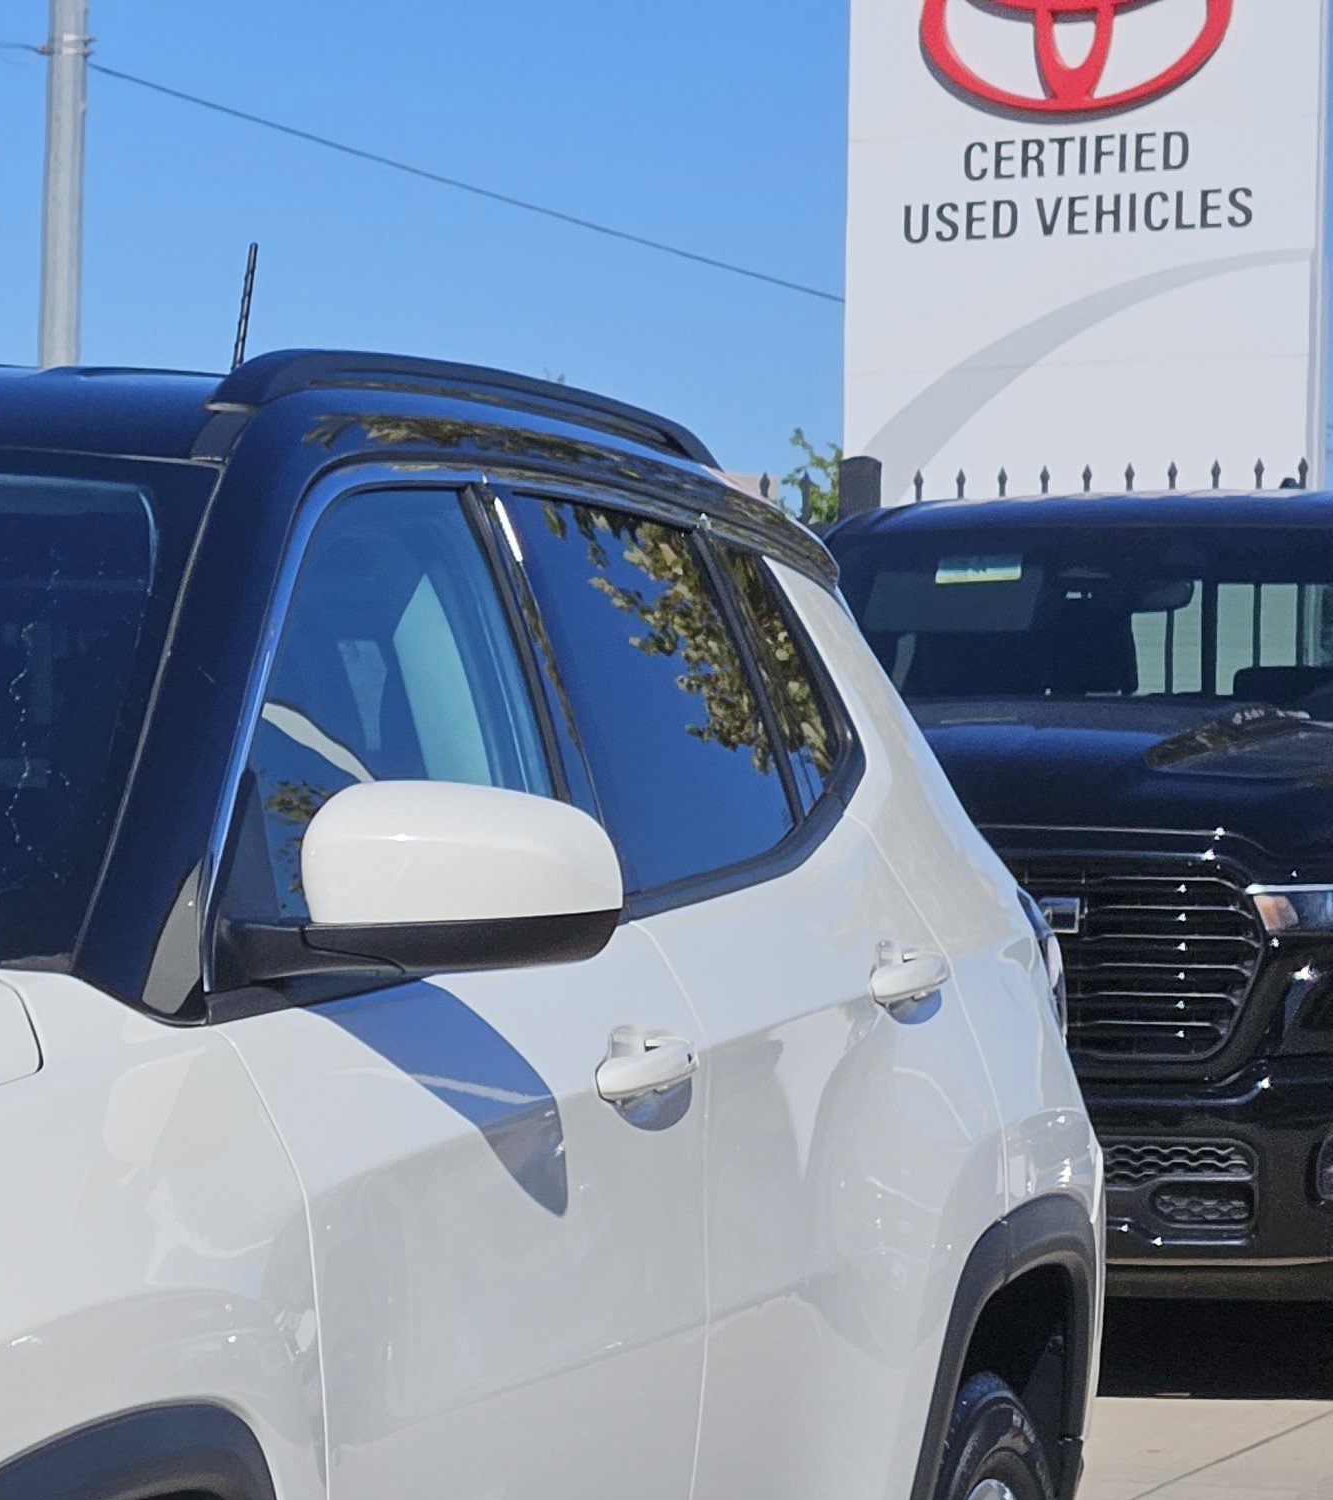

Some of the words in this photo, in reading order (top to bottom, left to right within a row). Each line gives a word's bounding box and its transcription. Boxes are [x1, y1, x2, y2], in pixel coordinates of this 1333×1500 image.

[963, 131, 1190, 181] CERTIFIED
[903, 200, 1019, 244] USED
[1035, 187, 1254, 237] VEHICLES
